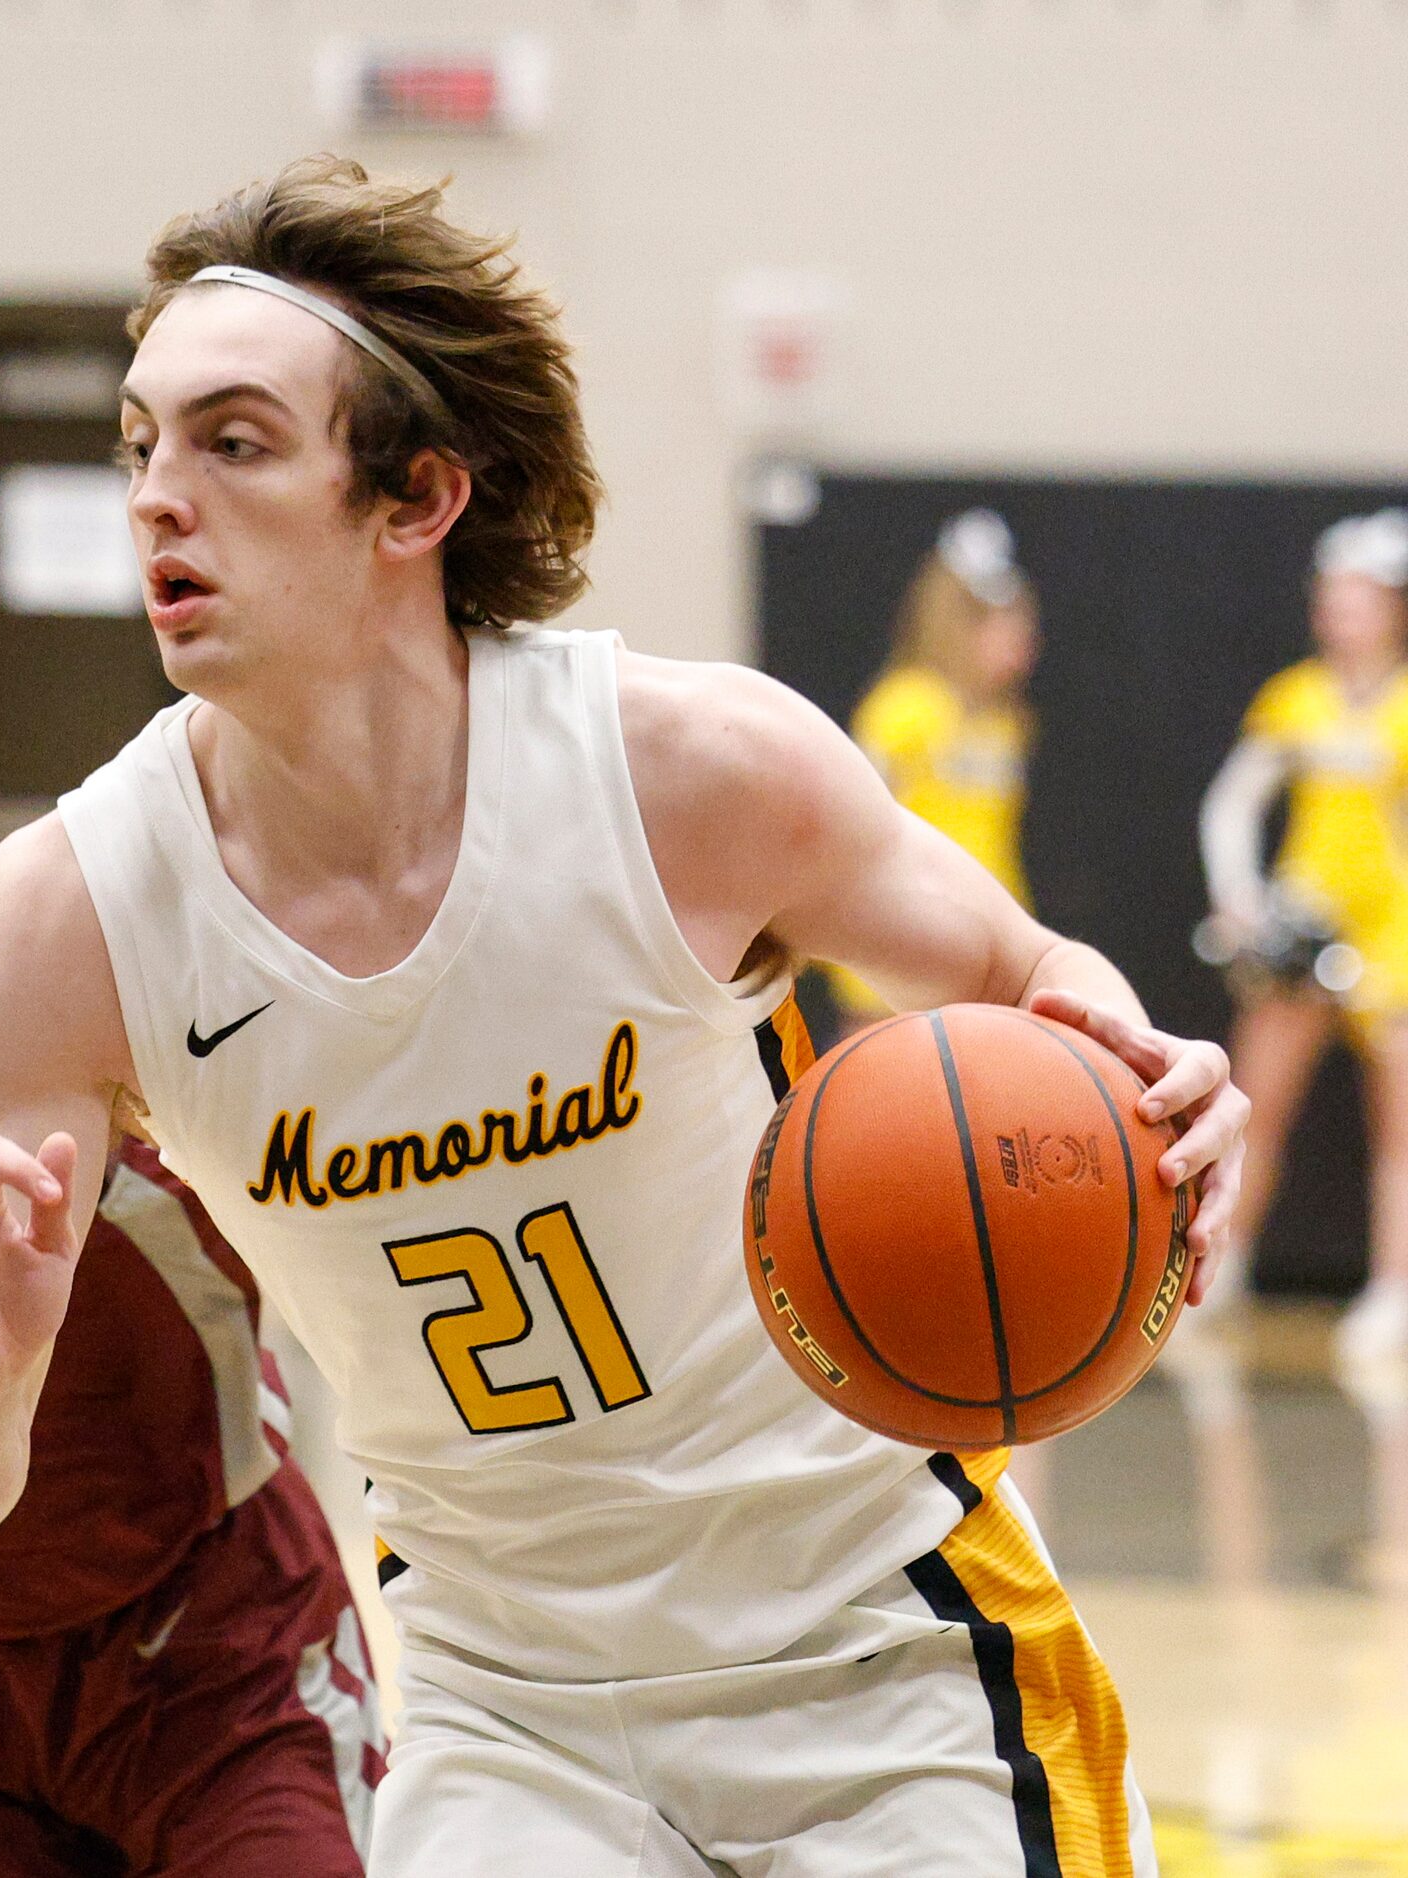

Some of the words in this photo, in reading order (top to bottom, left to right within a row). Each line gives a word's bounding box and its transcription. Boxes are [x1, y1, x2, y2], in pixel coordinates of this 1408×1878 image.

[246, 1019, 643, 1210] Memorial
[381, 1201, 653, 1435] 21
[1147, 1239, 1187, 1335] PRO
